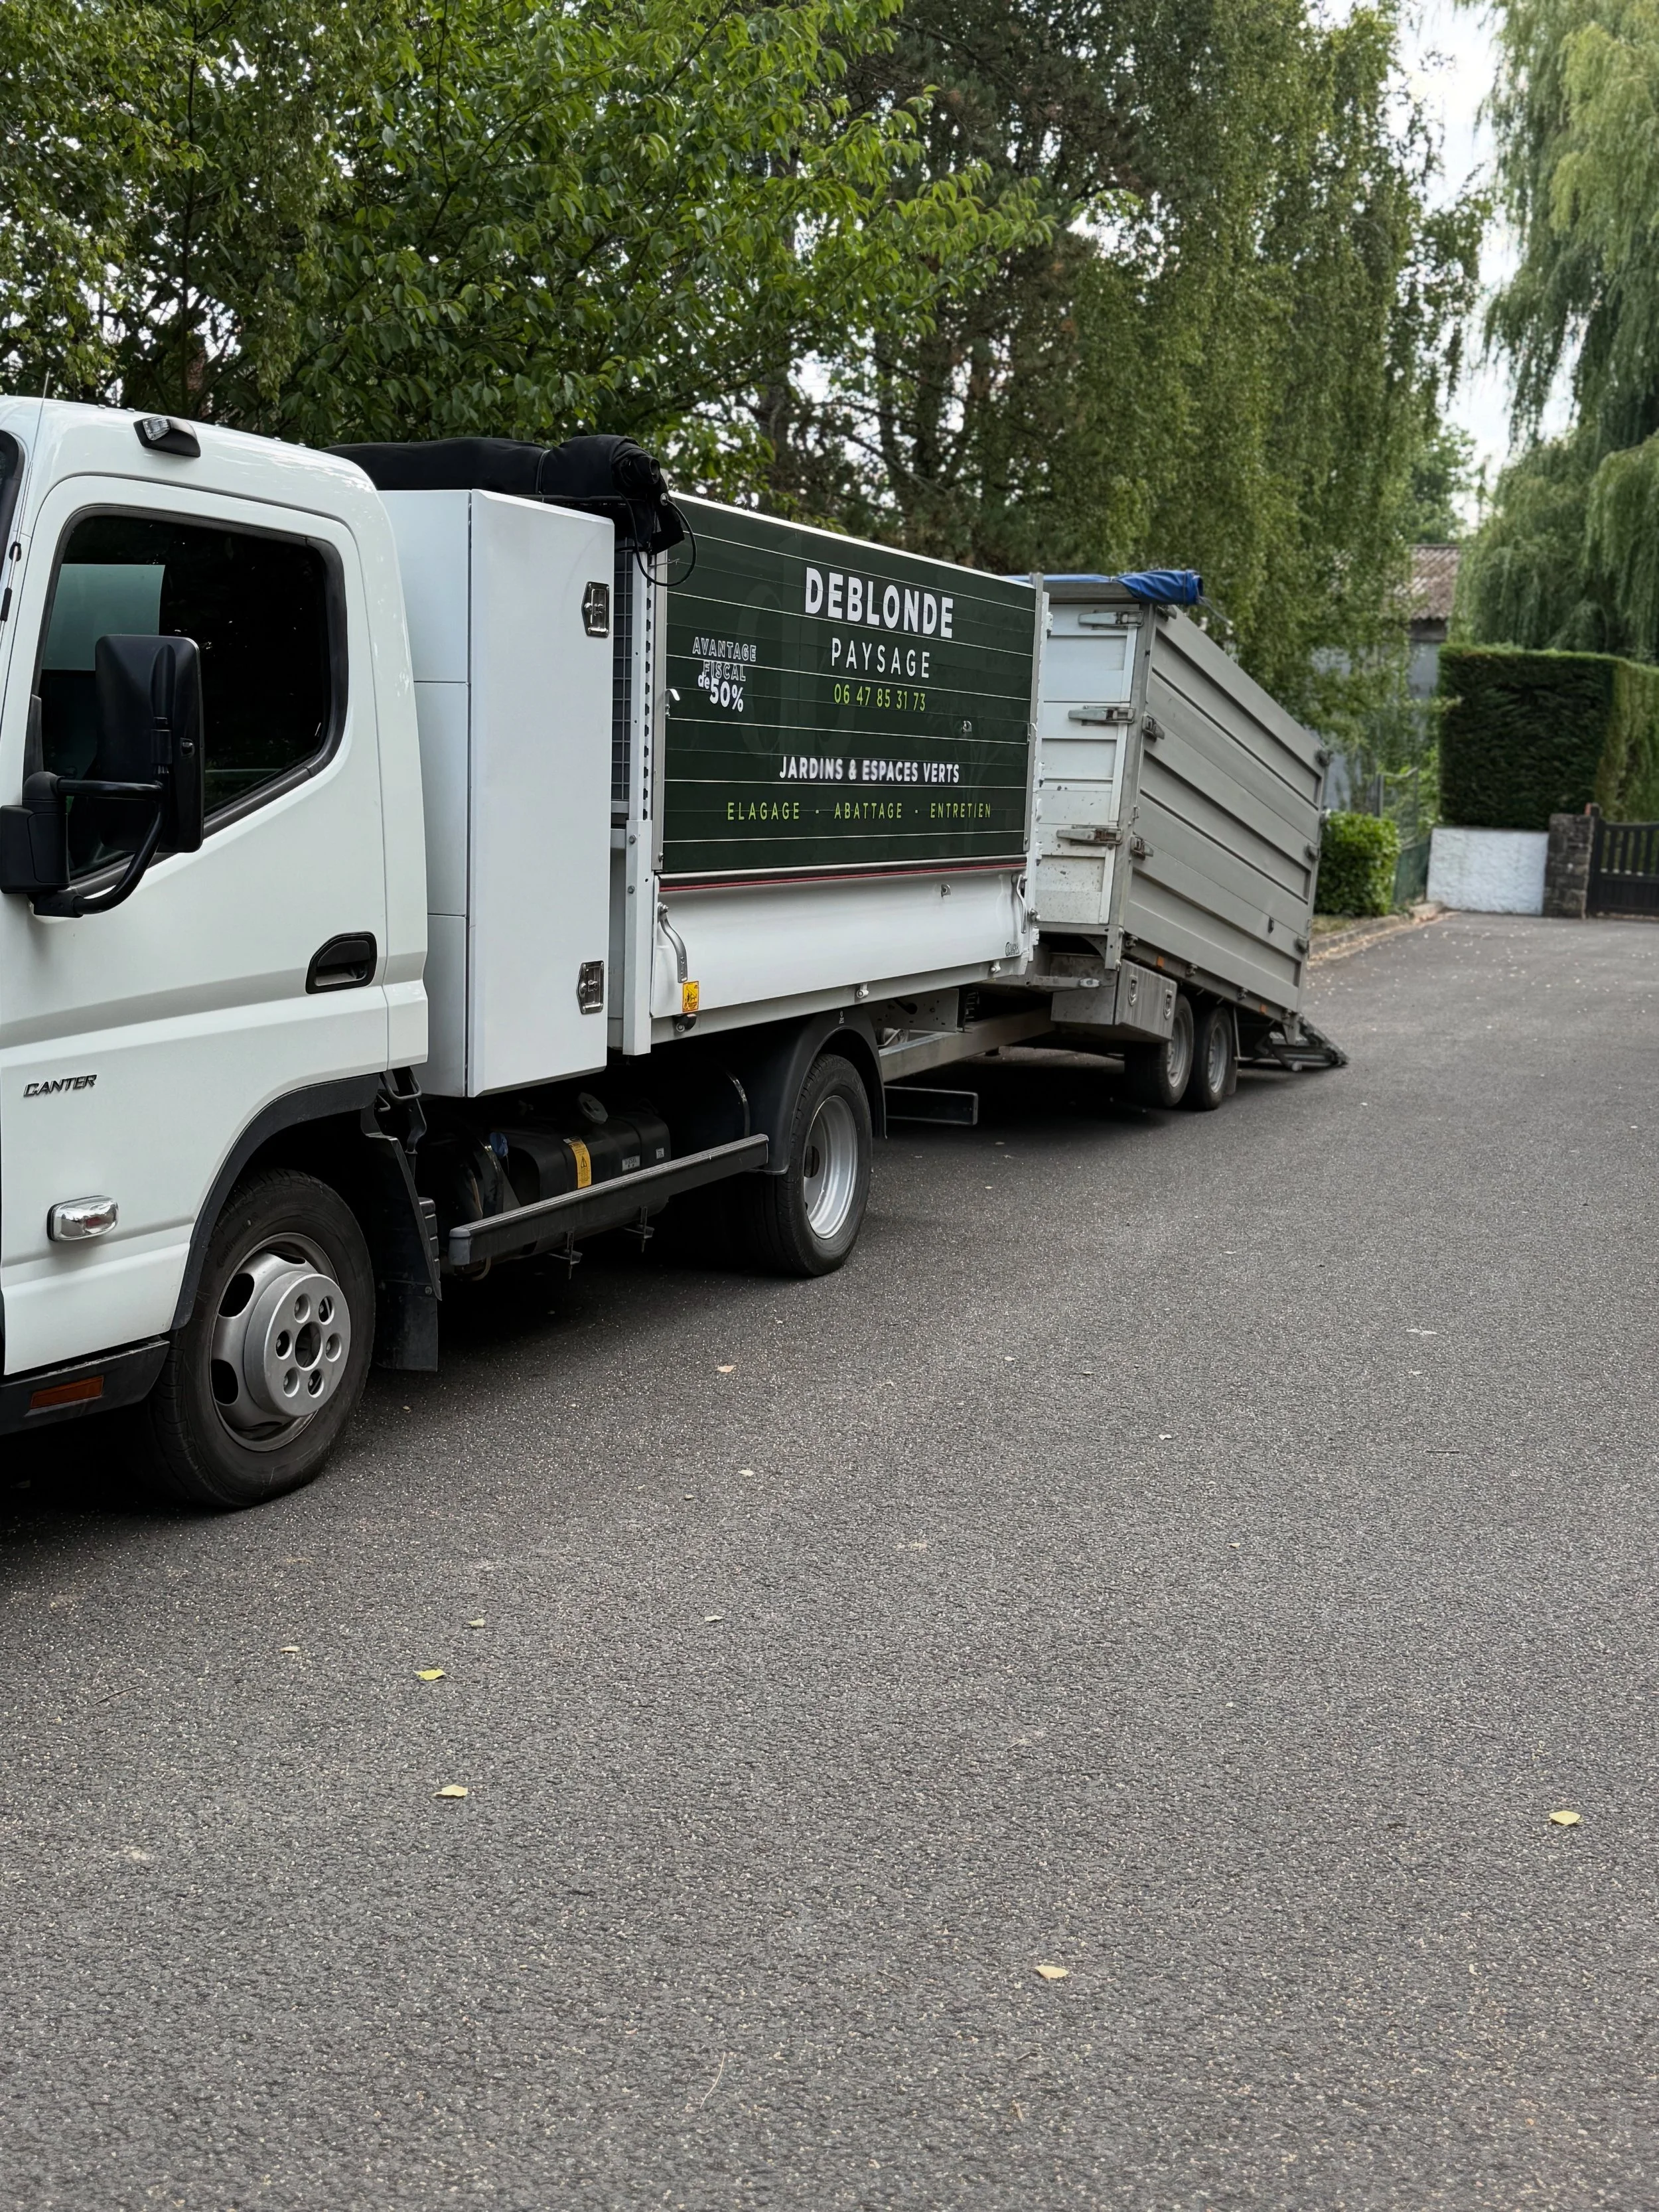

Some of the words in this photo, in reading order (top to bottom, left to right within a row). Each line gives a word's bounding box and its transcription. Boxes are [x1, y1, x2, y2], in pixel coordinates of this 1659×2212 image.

[805, 567, 954, 638] DEBLONDE
[692, 636, 757, 662] AVANTAGE
[831, 637, 930, 678] PAYSAGE
[703, 660, 747, 682] FISCAL
[709, 677, 744, 712] 50%
[834, 684, 850, 704] 06
[856, 686, 871, 706] 47
[877, 688, 891, 708] 85
[896, 690, 908, 709] 31
[912, 692, 926, 711] 73
[779, 756, 843, 780] JARDINS
[848, 759, 857, 780] &
[862, 761, 918, 782] ESPACES
[923, 763, 960, 783] VERTS
[727, 802, 800, 820] ELAGAGE
[834, 802, 902, 820] ABATTAGE
[930, 802, 991, 818] ENTRETIEN
[23, 1074, 98, 1098] CANTER
